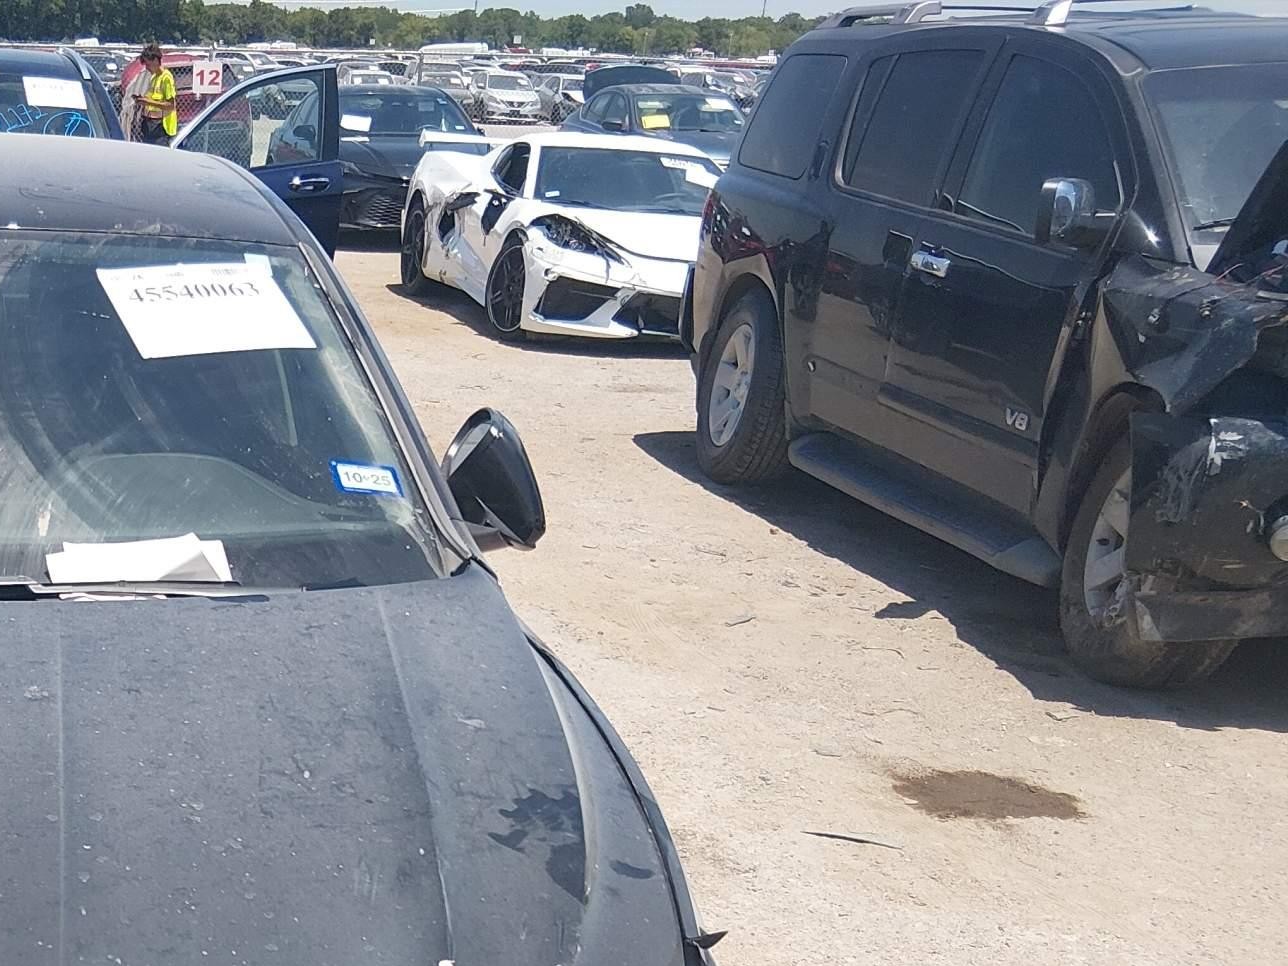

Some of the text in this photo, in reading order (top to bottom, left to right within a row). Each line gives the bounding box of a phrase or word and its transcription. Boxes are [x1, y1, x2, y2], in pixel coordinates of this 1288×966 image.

[196, 69, 221, 86] 12
[129, 282, 260, 303] 45540063
[1005, 407, 1029, 431] V8
